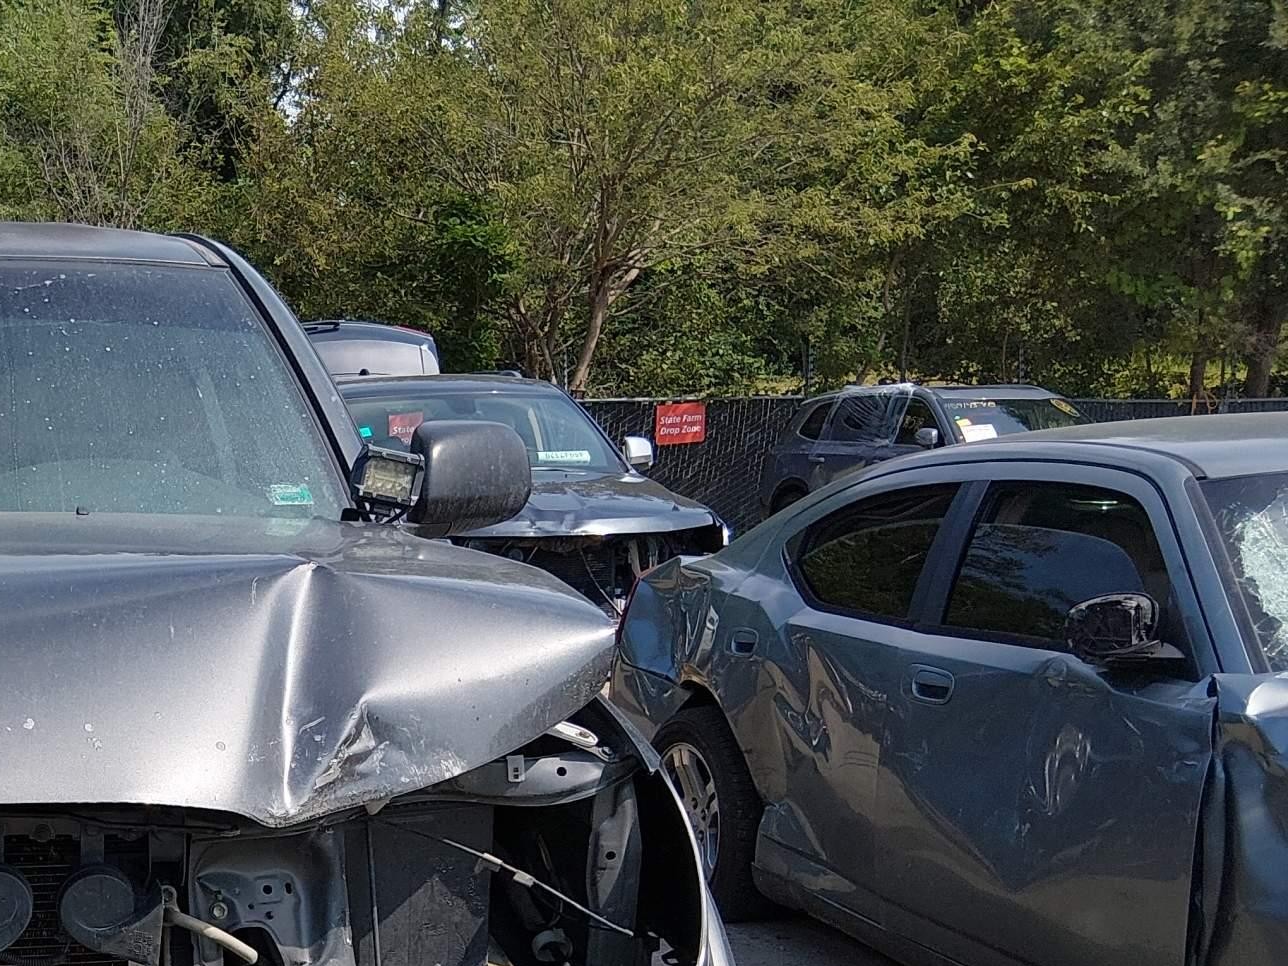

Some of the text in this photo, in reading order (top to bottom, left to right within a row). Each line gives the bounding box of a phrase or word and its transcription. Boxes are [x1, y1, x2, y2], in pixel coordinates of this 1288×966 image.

[659, 414, 702, 425] State Farm
[659, 425, 702, 436] Drop Zone
